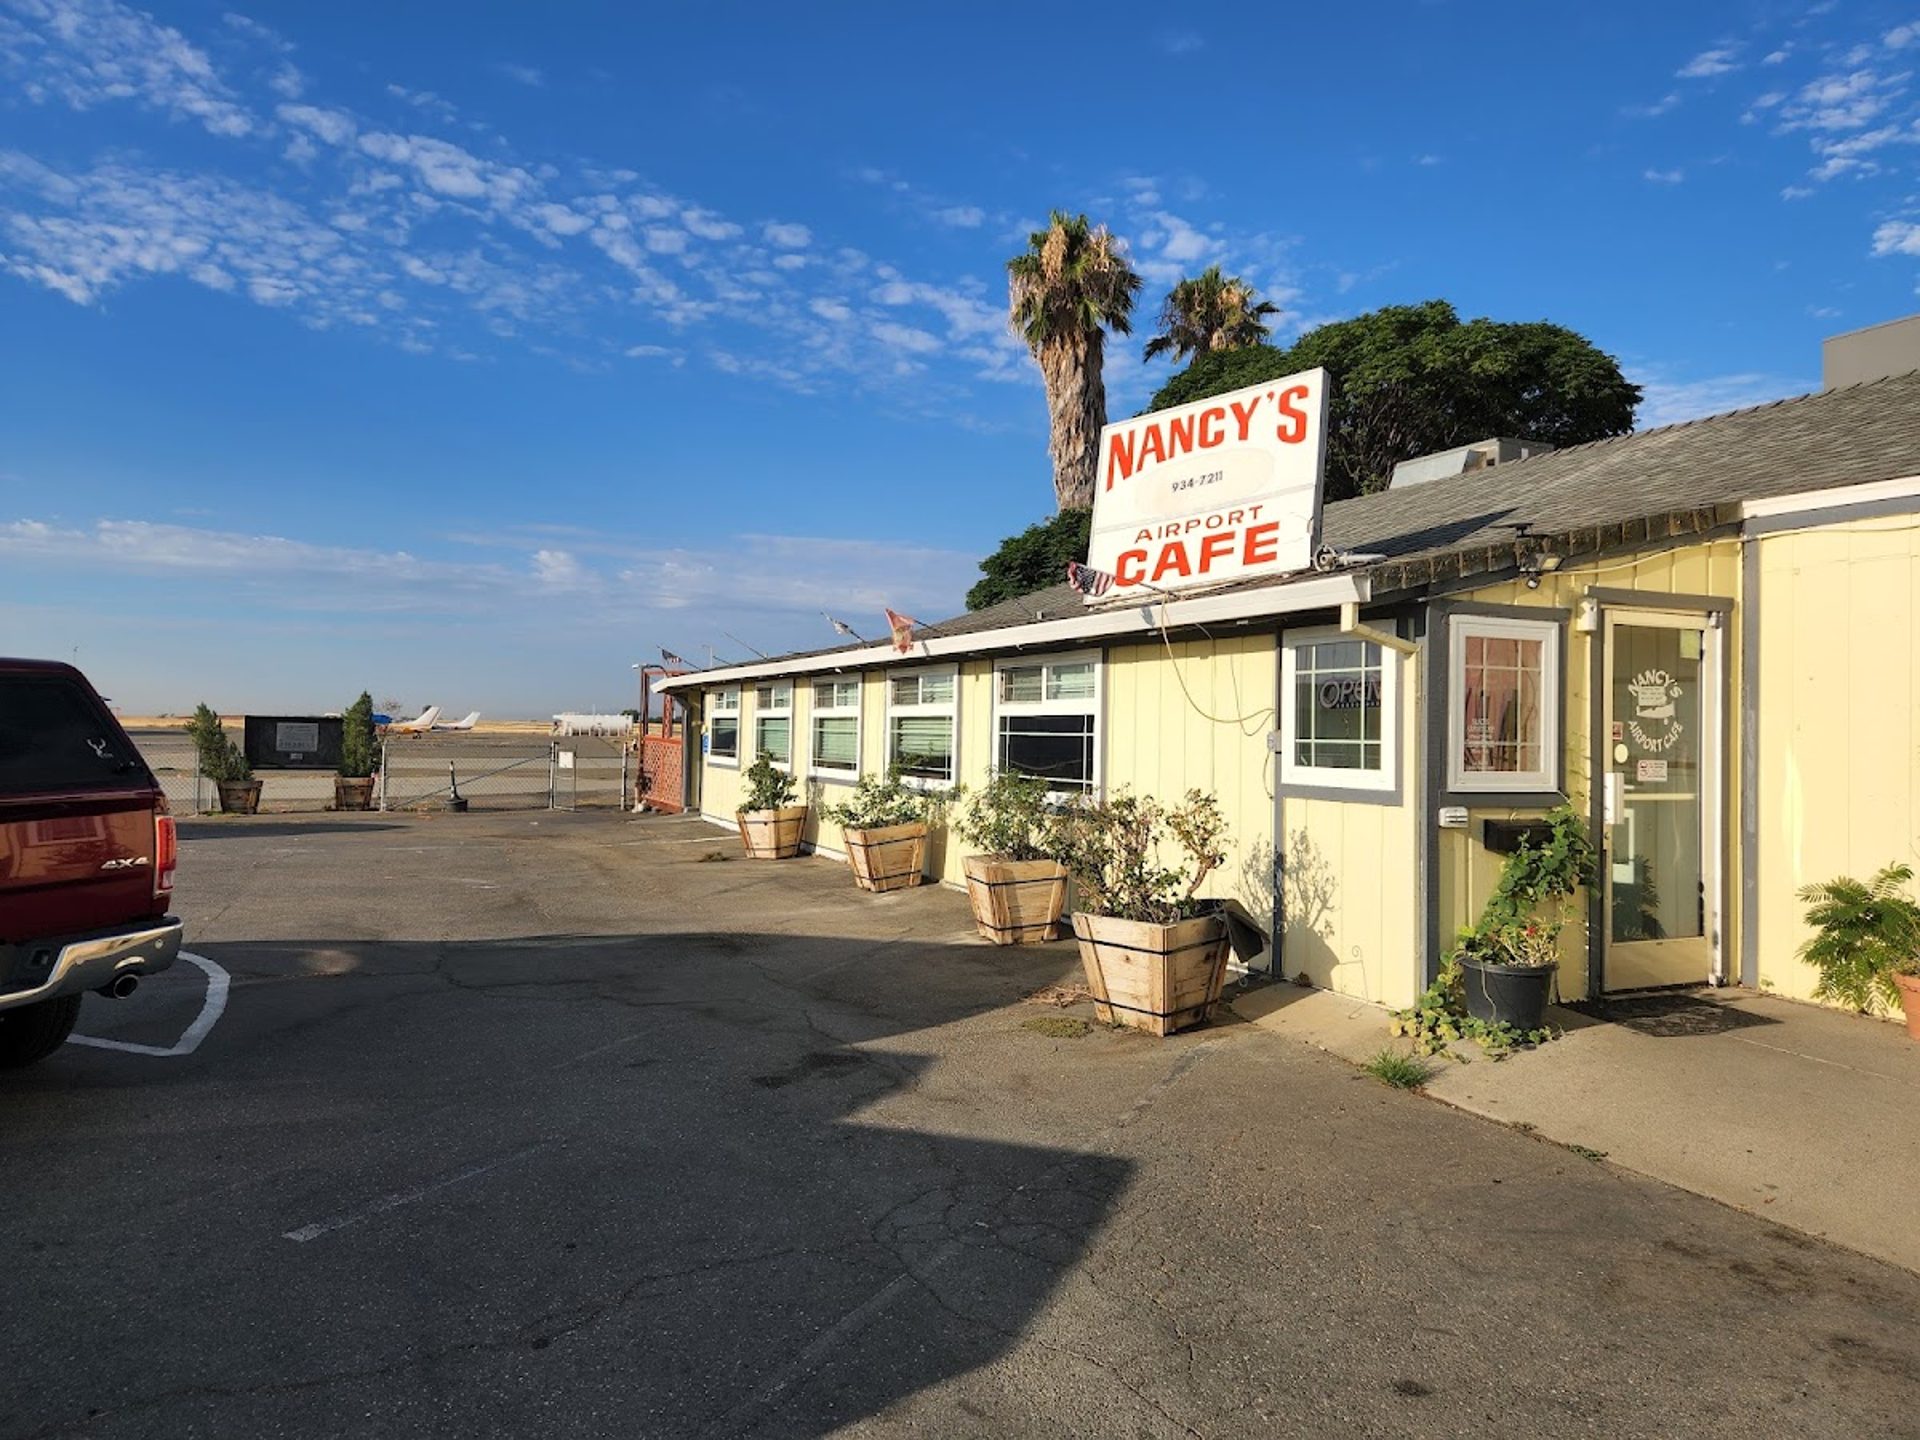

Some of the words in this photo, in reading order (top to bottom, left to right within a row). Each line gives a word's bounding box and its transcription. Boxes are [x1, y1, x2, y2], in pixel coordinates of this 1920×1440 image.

[1106, 385, 1309, 492] NANCY'S
[1172, 470, 1224, 493] 934-7211
[1134, 505, 1264, 544] AIRPORT
[1114, 521, 1280, 588] CAFE
[1628, 669, 1683, 697] NANCY'S
[1628, 721, 1663, 752] AIRPORT
[1663, 721, 1684, 749] CAFE
